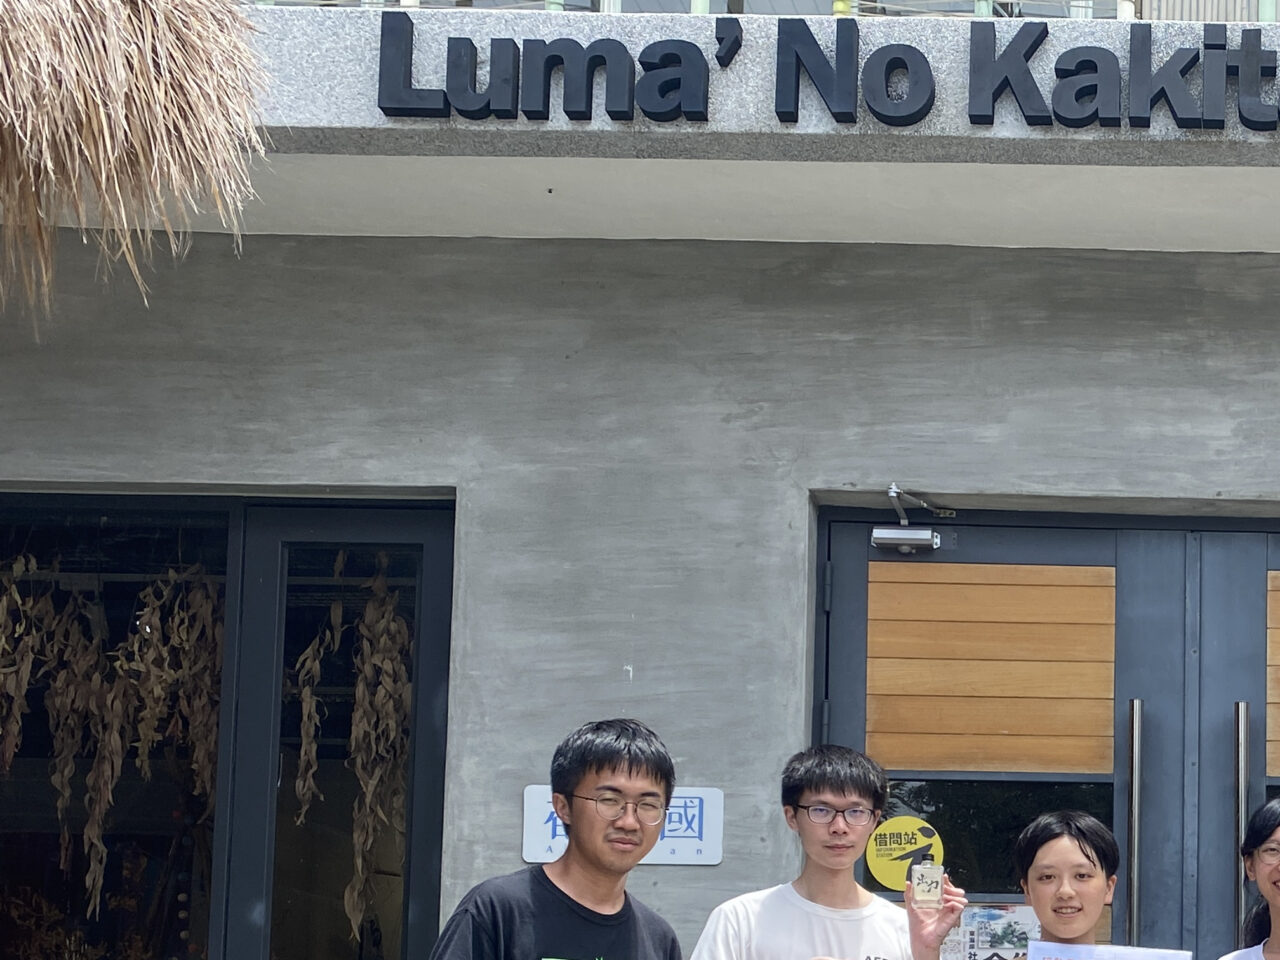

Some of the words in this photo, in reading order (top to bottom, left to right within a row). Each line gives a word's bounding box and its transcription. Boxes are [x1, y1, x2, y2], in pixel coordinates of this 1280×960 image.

[776, 17, 935, 127] No
[874, 831, 918, 847] 借問站
